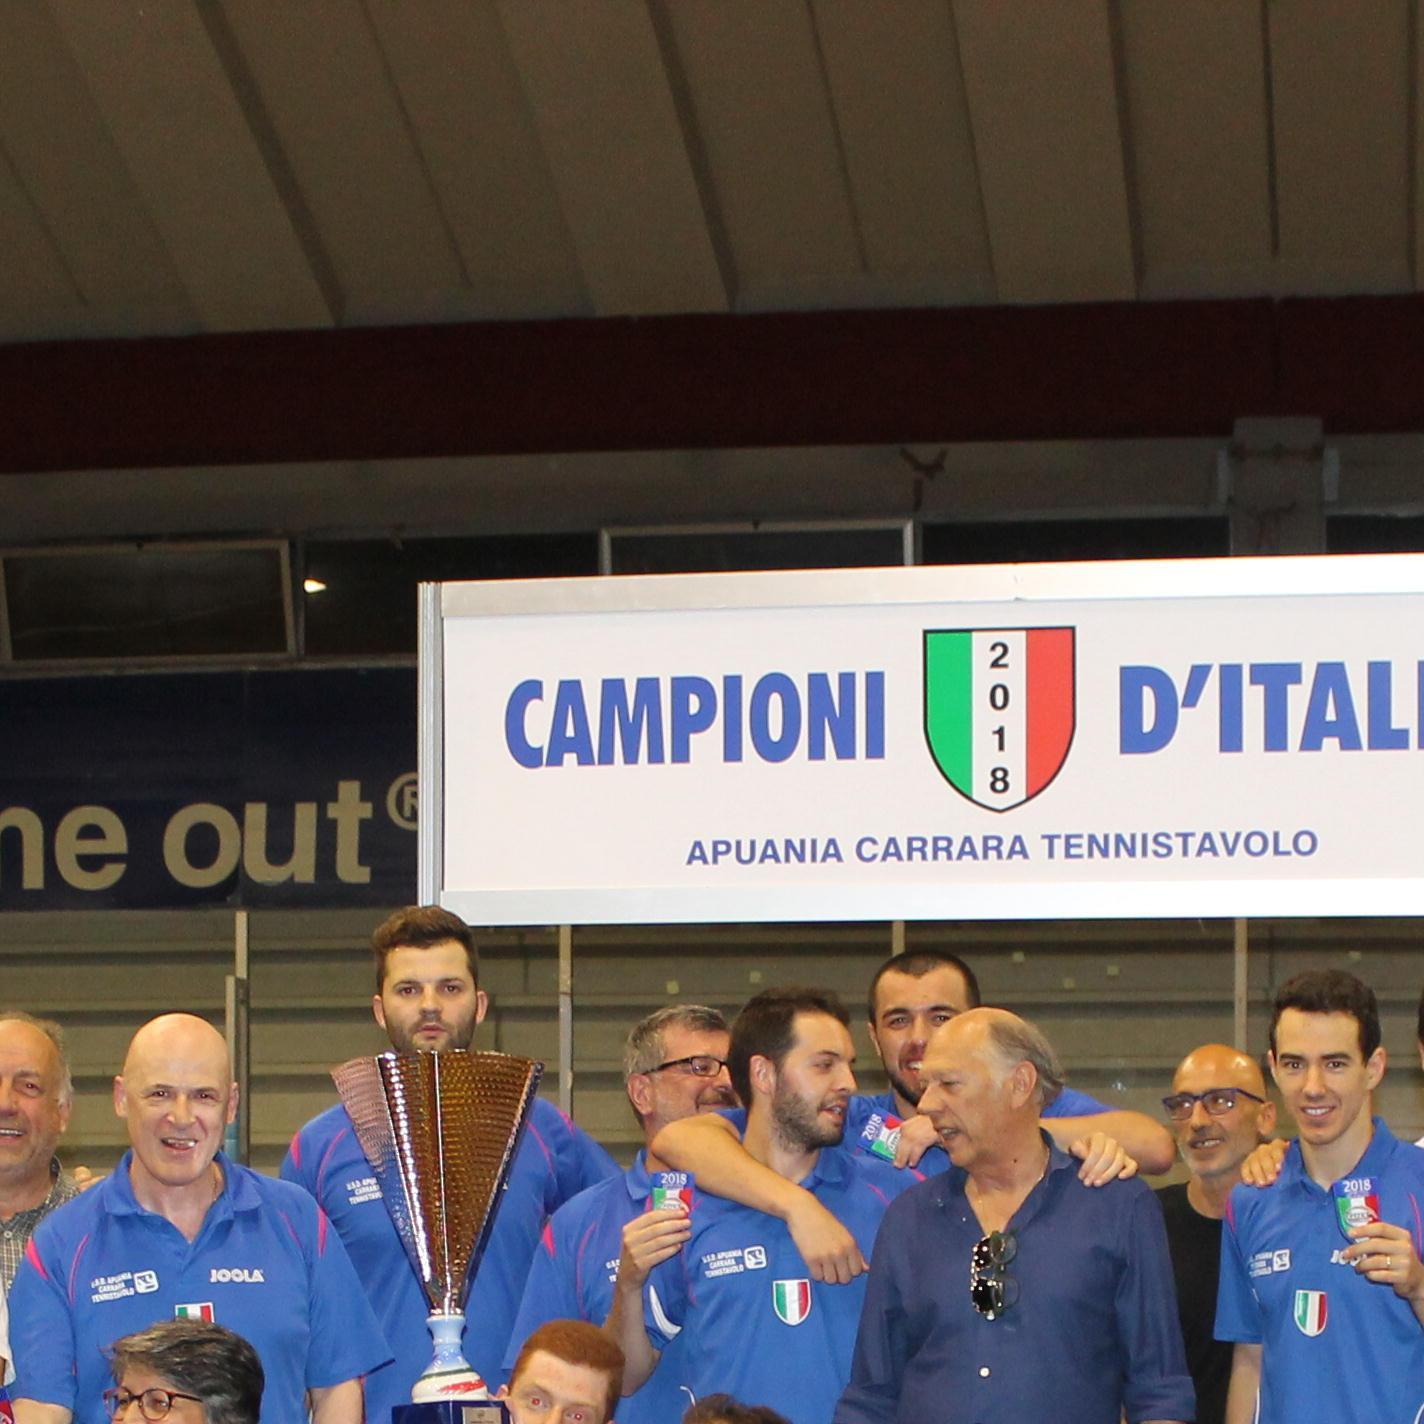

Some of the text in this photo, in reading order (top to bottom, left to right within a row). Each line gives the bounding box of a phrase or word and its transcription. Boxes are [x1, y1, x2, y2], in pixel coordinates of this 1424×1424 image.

[504, 671, 886, 770] CAMPIONI
[162, 780, 373, 888] out
[685, 829, 1319, 866] APUANIA CARRARA TENNISTAVOLO
[660, 1172, 688, 1185] 2018
[1342, 1178, 1372, 1193] 2018
[209, 1268, 264, 1283] JOOLA
